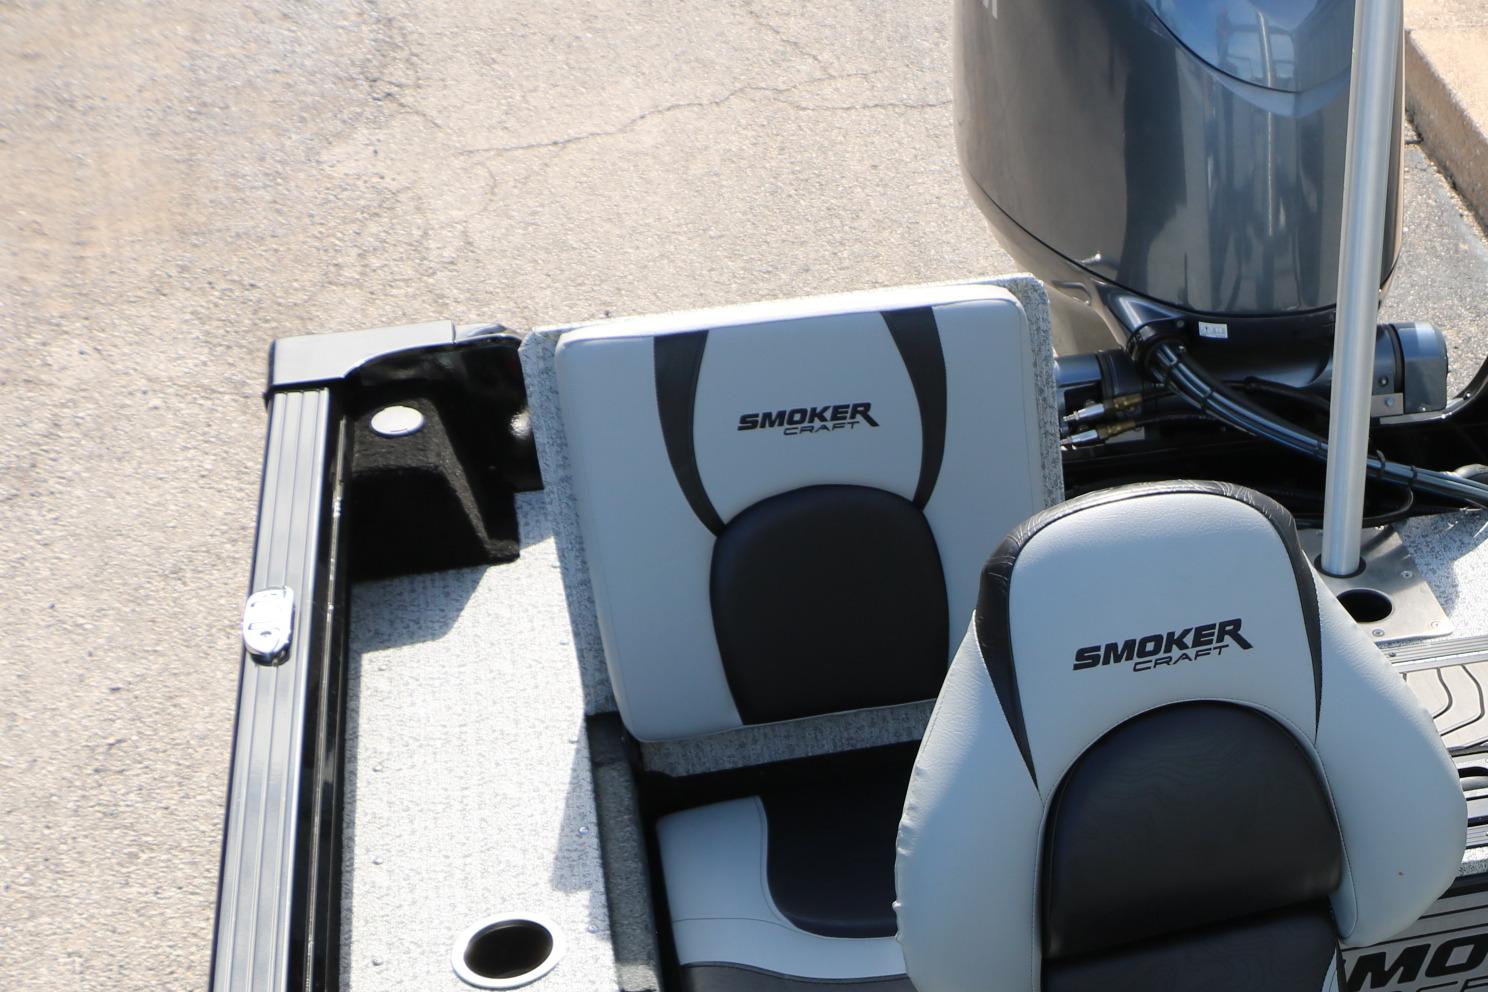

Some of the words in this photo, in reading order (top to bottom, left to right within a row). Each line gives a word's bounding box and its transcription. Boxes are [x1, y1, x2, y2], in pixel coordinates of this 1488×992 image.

[737, 402, 879, 431] SMOKER
[783, 421, 860, 436] CRAFT
[1073, 618, 1253, 671] SMOKER
[1133, 644, 1229, 672] CRAFT
